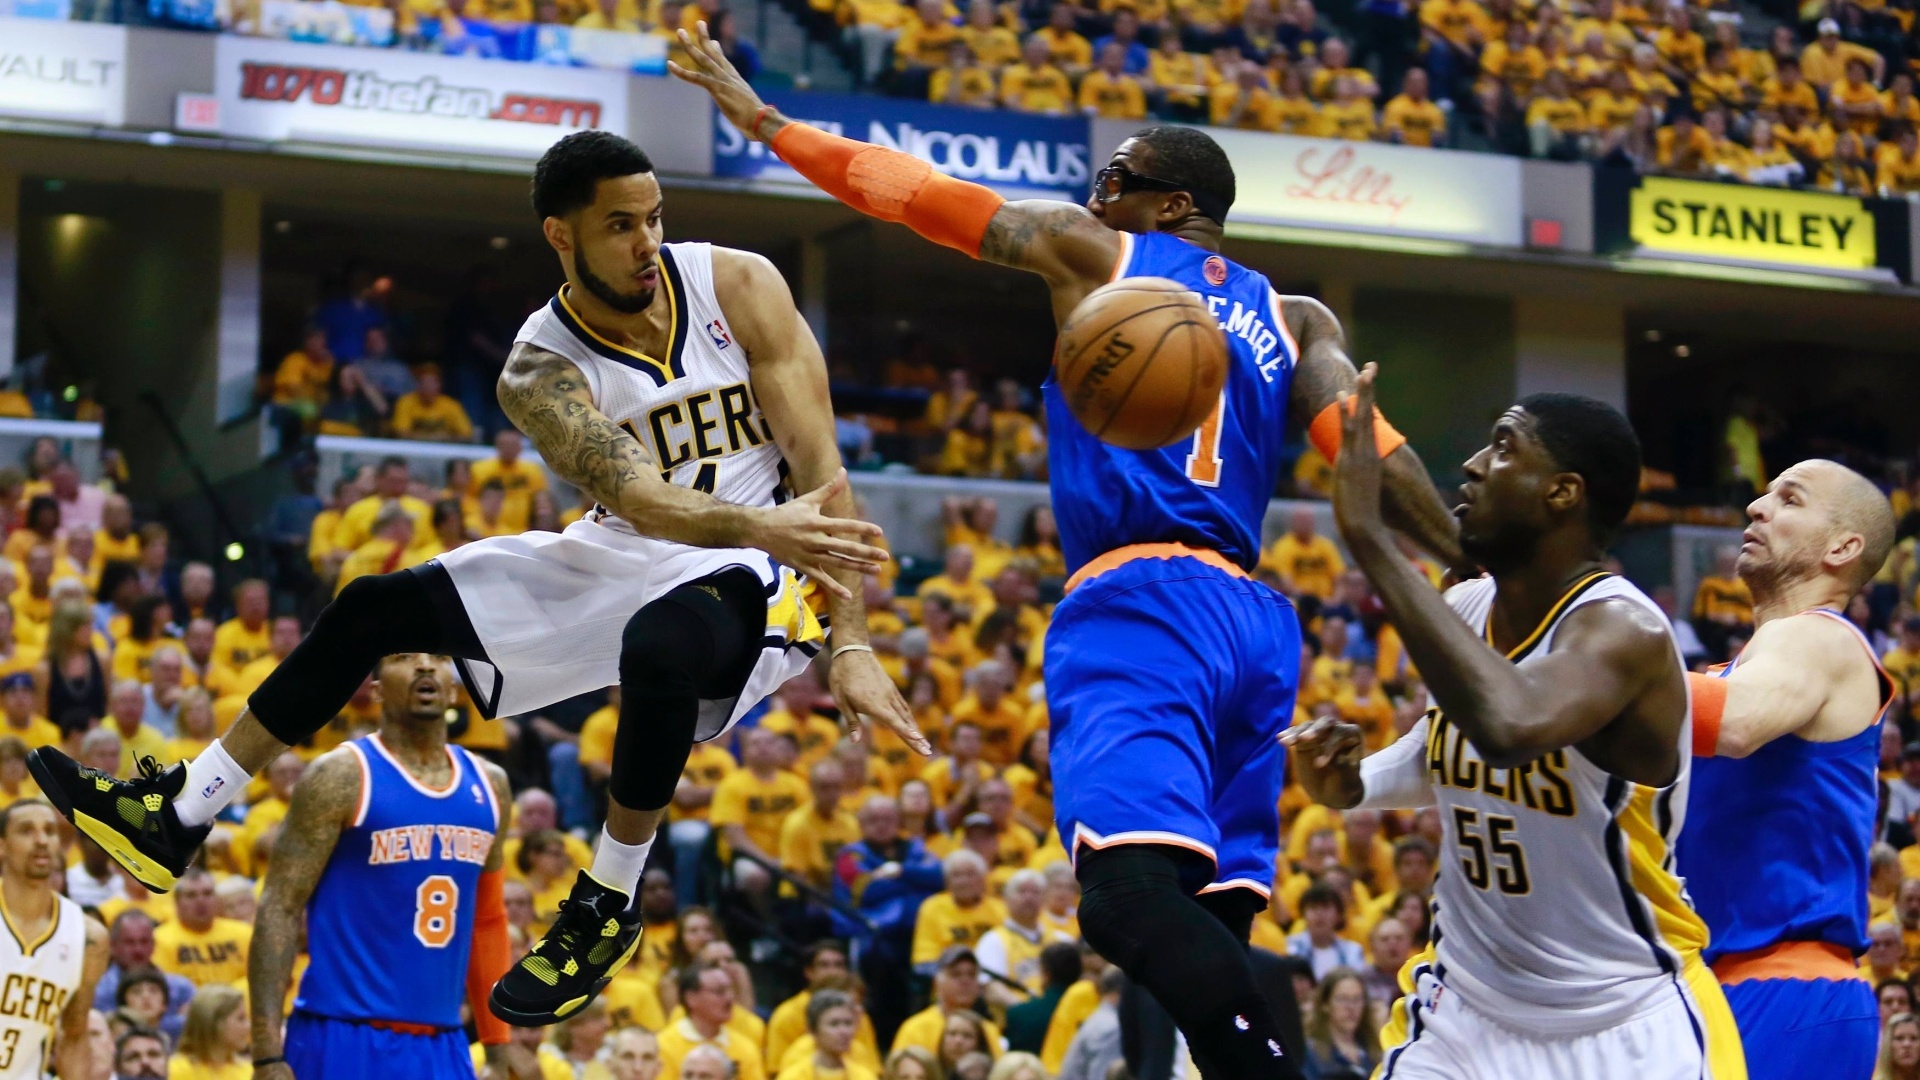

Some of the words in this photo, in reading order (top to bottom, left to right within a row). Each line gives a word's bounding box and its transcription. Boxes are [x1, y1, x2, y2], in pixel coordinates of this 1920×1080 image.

[1285, 145, 1412, 226] Lilly
[1653, 199, 1854, 250] STANLEY
[1196, 291, 1287, 383] EMIRE
[368, 824, 436, 866] NEW
[1451, 803, 1535, 897] 55
[413, 875, 459, 948] 8
